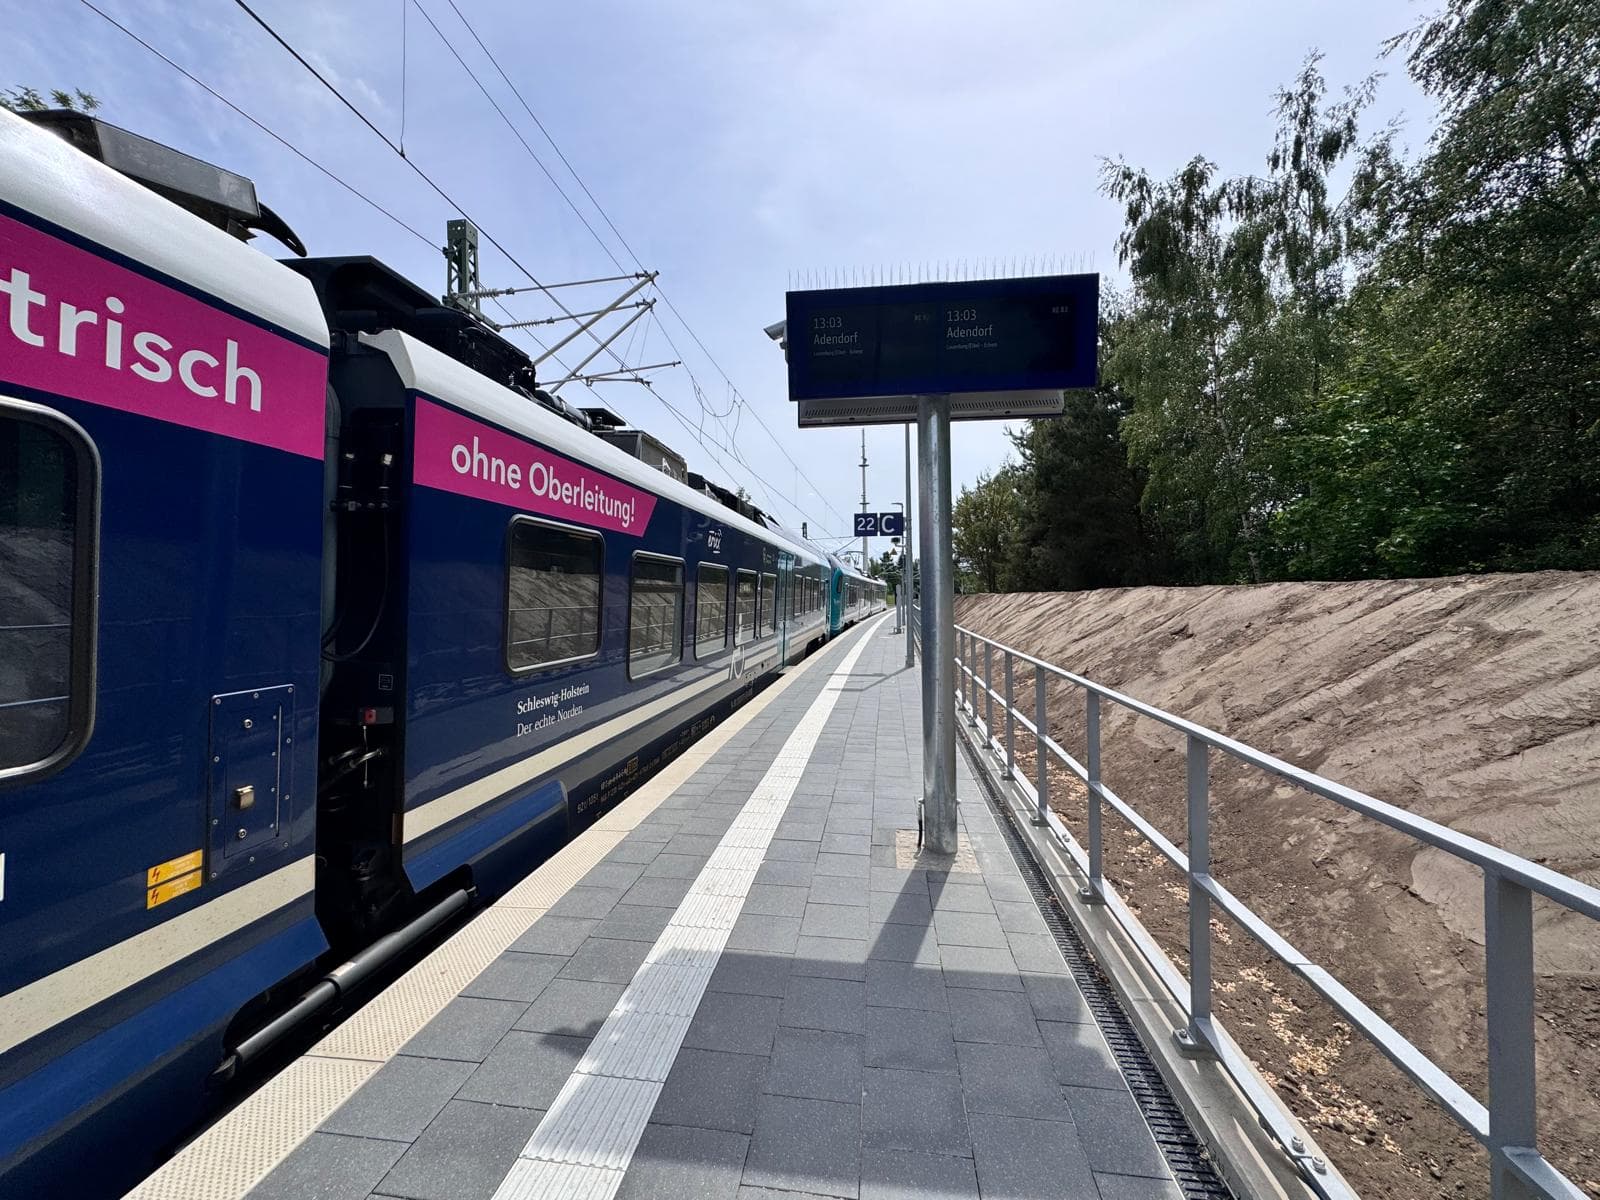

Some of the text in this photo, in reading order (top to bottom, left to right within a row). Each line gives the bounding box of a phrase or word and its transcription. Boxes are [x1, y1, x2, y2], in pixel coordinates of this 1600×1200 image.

[813, 317, 843, 329] 13:03
[946, 309, 977, 322] 13:03
[813, 331, 859, 345] Adendorf
[946, 324, 993, 339] Adendorf
[451, 436, 635, 528] ohne Oberleitung!
[857, 517, 875, 531] 22
[881, 514, 895, 533] C
[517, 683, 590, 715] Schleswig-Holstein
[517, 704, 583, 737] Der echte Norden
